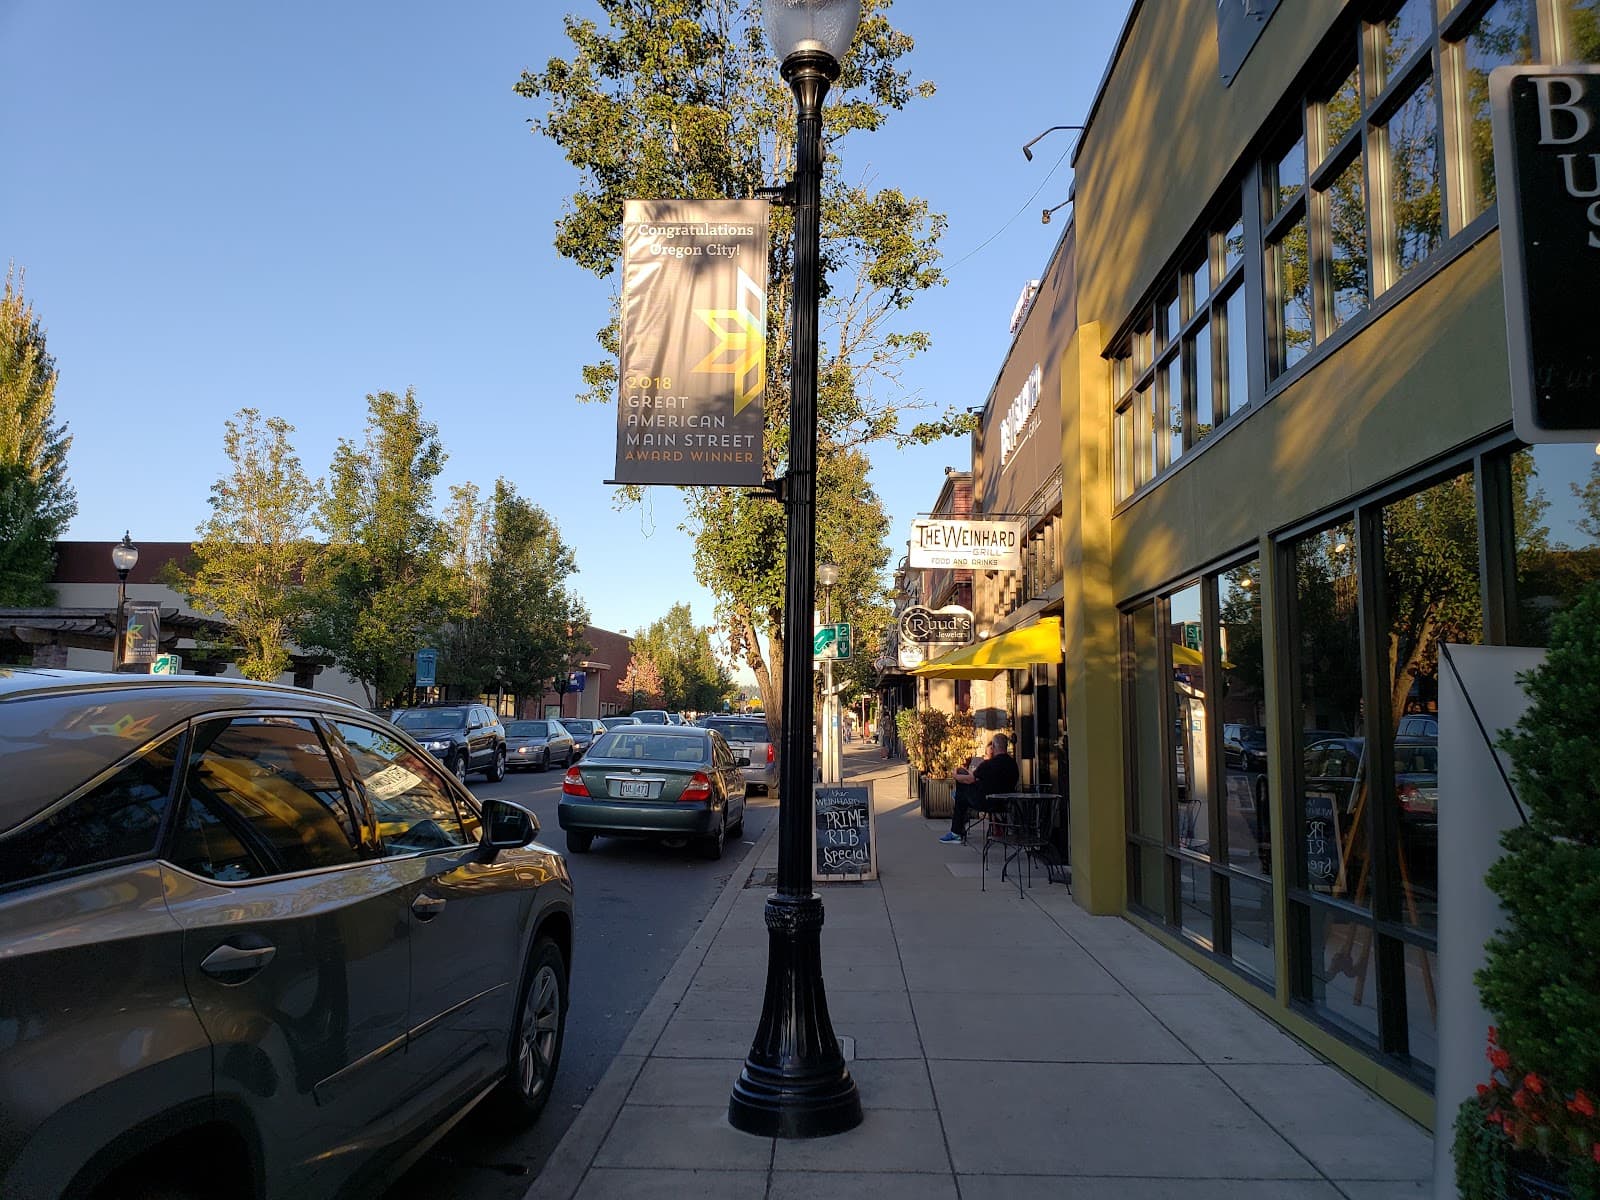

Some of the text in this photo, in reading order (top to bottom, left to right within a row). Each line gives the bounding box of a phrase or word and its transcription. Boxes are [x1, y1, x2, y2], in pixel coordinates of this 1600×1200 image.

[638, 222, 754, 239] Congratulations
[650, 243, 741, 259] Oregon City!
[625, 376, 673, 390] 2018
[627, 395, 689, 409] GREAT
[627, 414, 726, 429] AMERICAN
[626, 432, 755, 448] MAIN STREET
[625, 450, 753, 463] AWARD WINNER
[972, 548, 1001, 557] GRILL
[931, 557, 950, 565] FOOD
[971, 558, 998, 566] DRINKS
[840, 626, 847, 636] 2
[912, 616, 971, 633] Ruud's
[824, 809, 866, 829] PRIME
[825, 828, 860, 847] RIB
[823, 843, 869, 864] Special
